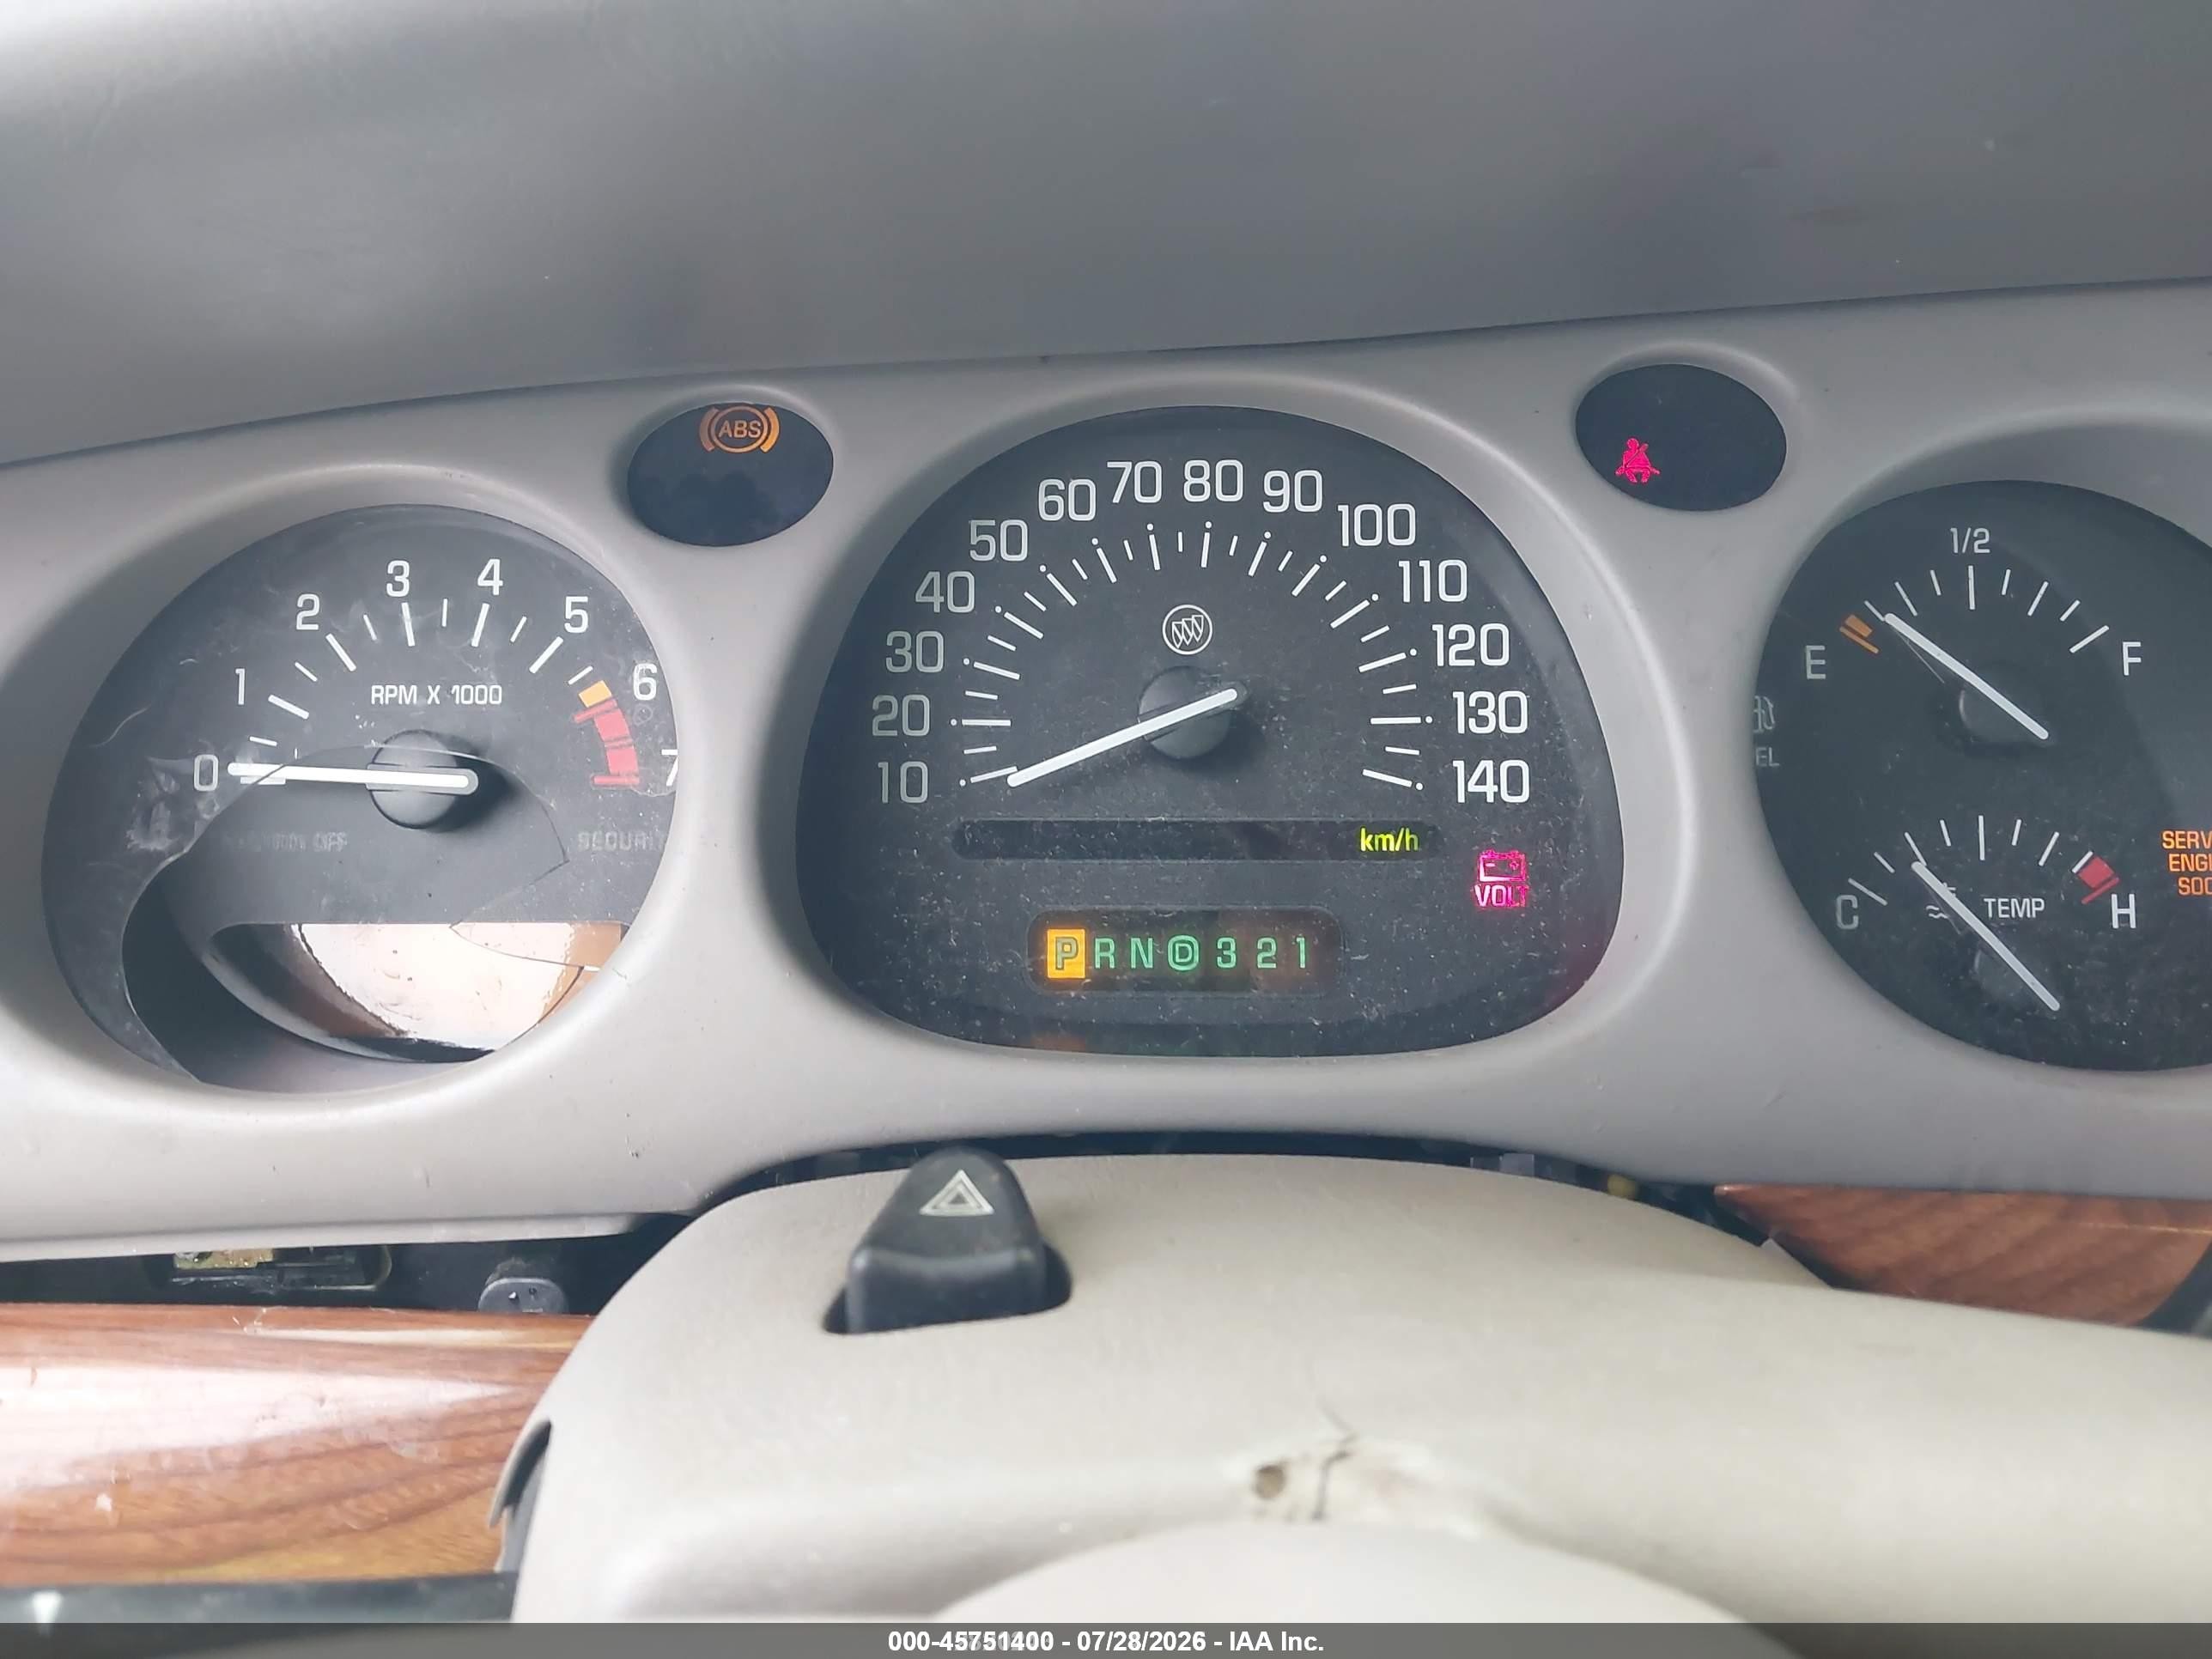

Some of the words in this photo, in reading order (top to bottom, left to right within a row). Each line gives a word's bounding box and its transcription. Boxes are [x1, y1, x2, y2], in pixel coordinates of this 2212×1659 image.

[718, 419, 762, 439] ABS
[1038, 478, 1097, 521] 60
[1107, 460, 1163, 503] 70
[1183, 459, 1243, 502] 80
[1262, 470, 1323, 513] 90
[969, 519, 1028, 562] 50
[1337, 503, 1416, 547] 100
[1950, 527, 1990, 554] 1/2
[386, 560, 410, 598] 3
[477, 558, 503, 596] 4
[915, 571, 975, 613] 40
[1398, 559, 1468, 603] 110
[295, 593, 320, 630] 2
[564, 596, 589, 634] 5
[885, 630, 945, 673] 30
[1431, 623, 1510, 666] 120
[1806, 645, 1826, 679] E
[2122, 641, 2142, 676] F
[235, 668, 246, 706] 1
[371, 684, 417, 705] RPM
[427, 684, 441, 705] X
[451, 684, 502, 705] 1000
[633, 663, 659, 701] 6
[872, 694, 930, 737] 20
[1452, 690, 1528, 734] 130
[193, 754, 219, 792] 0
[877, 761, 928, 804] 10
[1452, 759, 1530, 804] 140
[1360, 827, 1419, 852] km/h
[1474, 884, 1529, 908] VOLT
[1836, 894, 1859, 930] C
[1983, 897, 2045, 918] TEMP
[2111, 893, 2136, 929] H
[1055, 937, 1079, 969] P
[1095, 938, 1115, 969] R
[1130, 938, 1153, 969] N
[1217, 938, 1237, 969] 3
[1256, 938, 1277, 969] 2
[1295, 937, 1306, 969] 1
